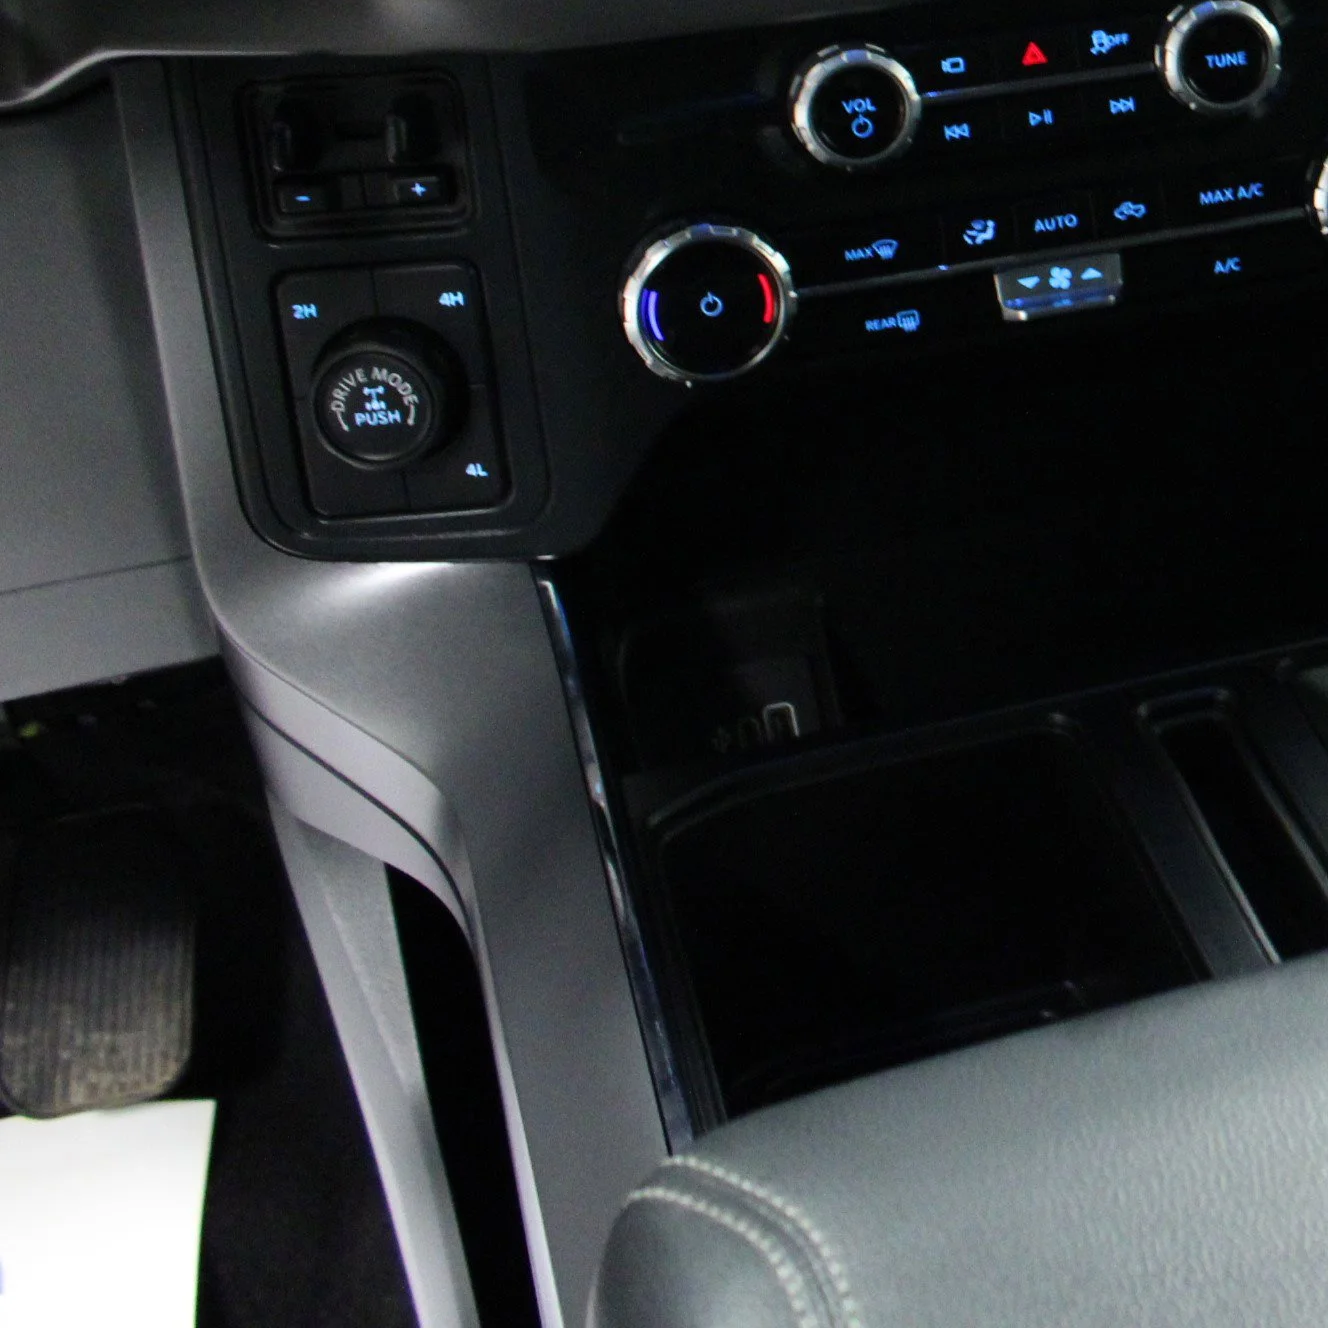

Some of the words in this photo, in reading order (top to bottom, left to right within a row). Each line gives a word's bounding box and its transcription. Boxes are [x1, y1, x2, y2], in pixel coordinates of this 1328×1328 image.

[1107, 30, 1131, 47] OFF
[1205, 50, 1248, 69] TUNE
[841, 97, 877, 114] VOL
[1199, 187, 1235, 205] MAX
[1236, 182, 1264, 199] A/C
[1034, 213, 1079, 233] AUTO
[844, 248, 873, 261] MAX
[1213, 256, 1241, 274] A/C
[438, 291, 465, 307] 4H
[291, 303, 318, 320] 2H
[865, 317, 897, 332] REAR
[330, 367, 368, 412] DRIVE
[371, 366, 419, 406] MODE
[354, 409, 402, 428] PUSH
[465, 462, 489, 477] 4L
